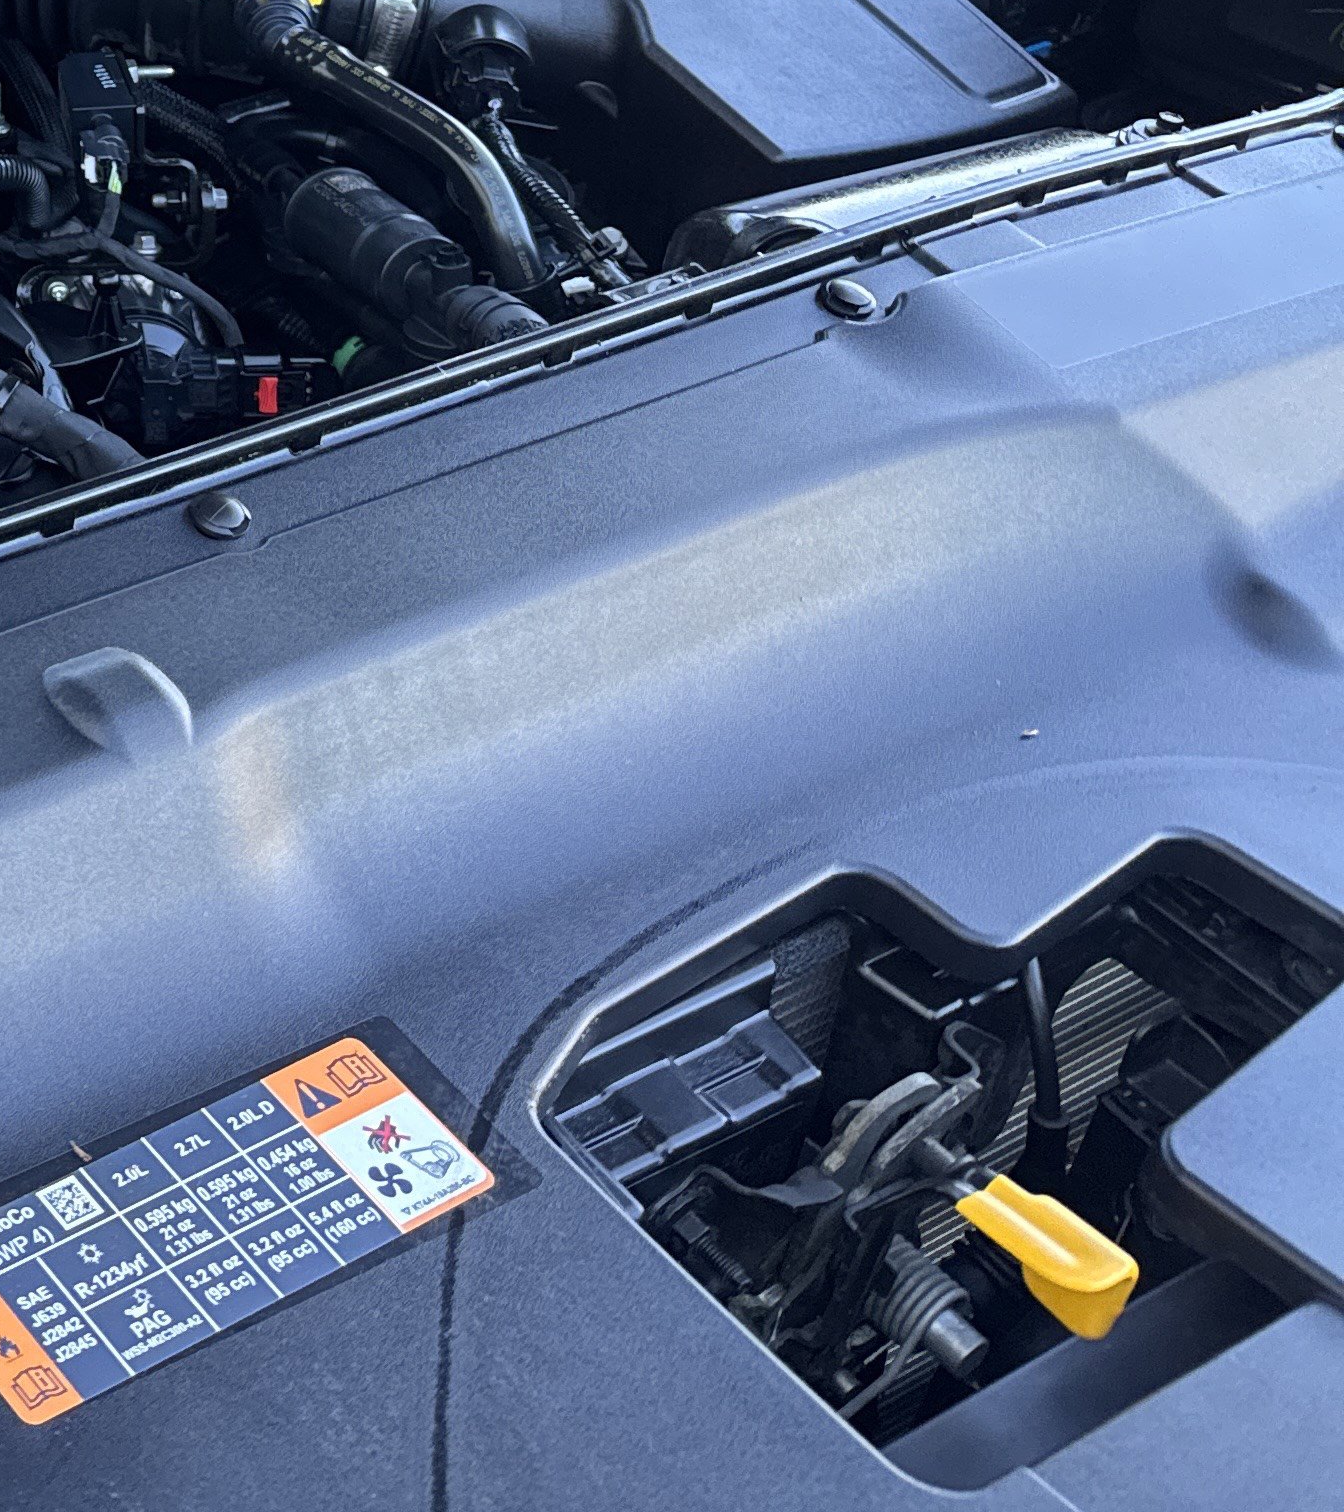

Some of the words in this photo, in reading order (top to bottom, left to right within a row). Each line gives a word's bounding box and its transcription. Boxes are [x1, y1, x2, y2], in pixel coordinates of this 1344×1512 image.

[226, 1108, 263, 1131] 2.0L
[258, 1100, 275, 1116] D
[173, 1134, 211, 1157] 2.7L
[256, 1144, 297, 1171] 0.454
[292, 1137, 319, 1153] kg
[112, 1164, 150, 1188] 2.0L
[283, 1163, 299, 1178] 16
[300, 1157, 317, 1171] oz
[289, 1175, 315, 1195] 1.00
[312, 1167, 336, 1184] lbs
[196, 1173, 237, 1202] 0.595
[232, 1166, 259, 1184] kg
[221, 1193, 240, 1210] 21
[239, 1187, 257, 1201] oz
[133, 1204, 175, 1233] 0.595
[170, 1197, 198, 1214] kg
[228, 1205, 256, 1225] 1.31
[252, 1198, 276, 1214] lbs
[308, 1206, 334, 1226] 5.4
[329, 1199, 346, 1214] fl
[344, 1192, 365, 1207] oz
[32, 1225, 55, 1244] 4)
[159, 1224, 177, 1241] 21
[177, 1218, 196, 1232] oz
[247, 1237, 275, 1257] 3.2
[284, 1223, 306, 1238] oz
[323, 1217, 358, 1244] (160
[356, 1206, 382, 1226] cc)
[165, 1238, 193, 1258] 1.31
[189, 1228, 213, 1245] lbs
[267, 1250, 294, 1273] (95
[292, 1238, 319, 1259] cc)
[73, 1252, 149, 1300] R-1234yf
[184, 1269, 211, 1289] 3.2
[222, 1254, 244, 1270] oz
[16, 1285, 54, 1310] SAE
[203, 1283, 231, 1306] (95
[229, 1270, 257, 1290] cc)
[31, 1302, 67, 1328] J639
[129, 1309, 172, 1338] PAG
[42, 1316, 85, 1346] J2842
[55, 1332, 98, 1363] J2845
